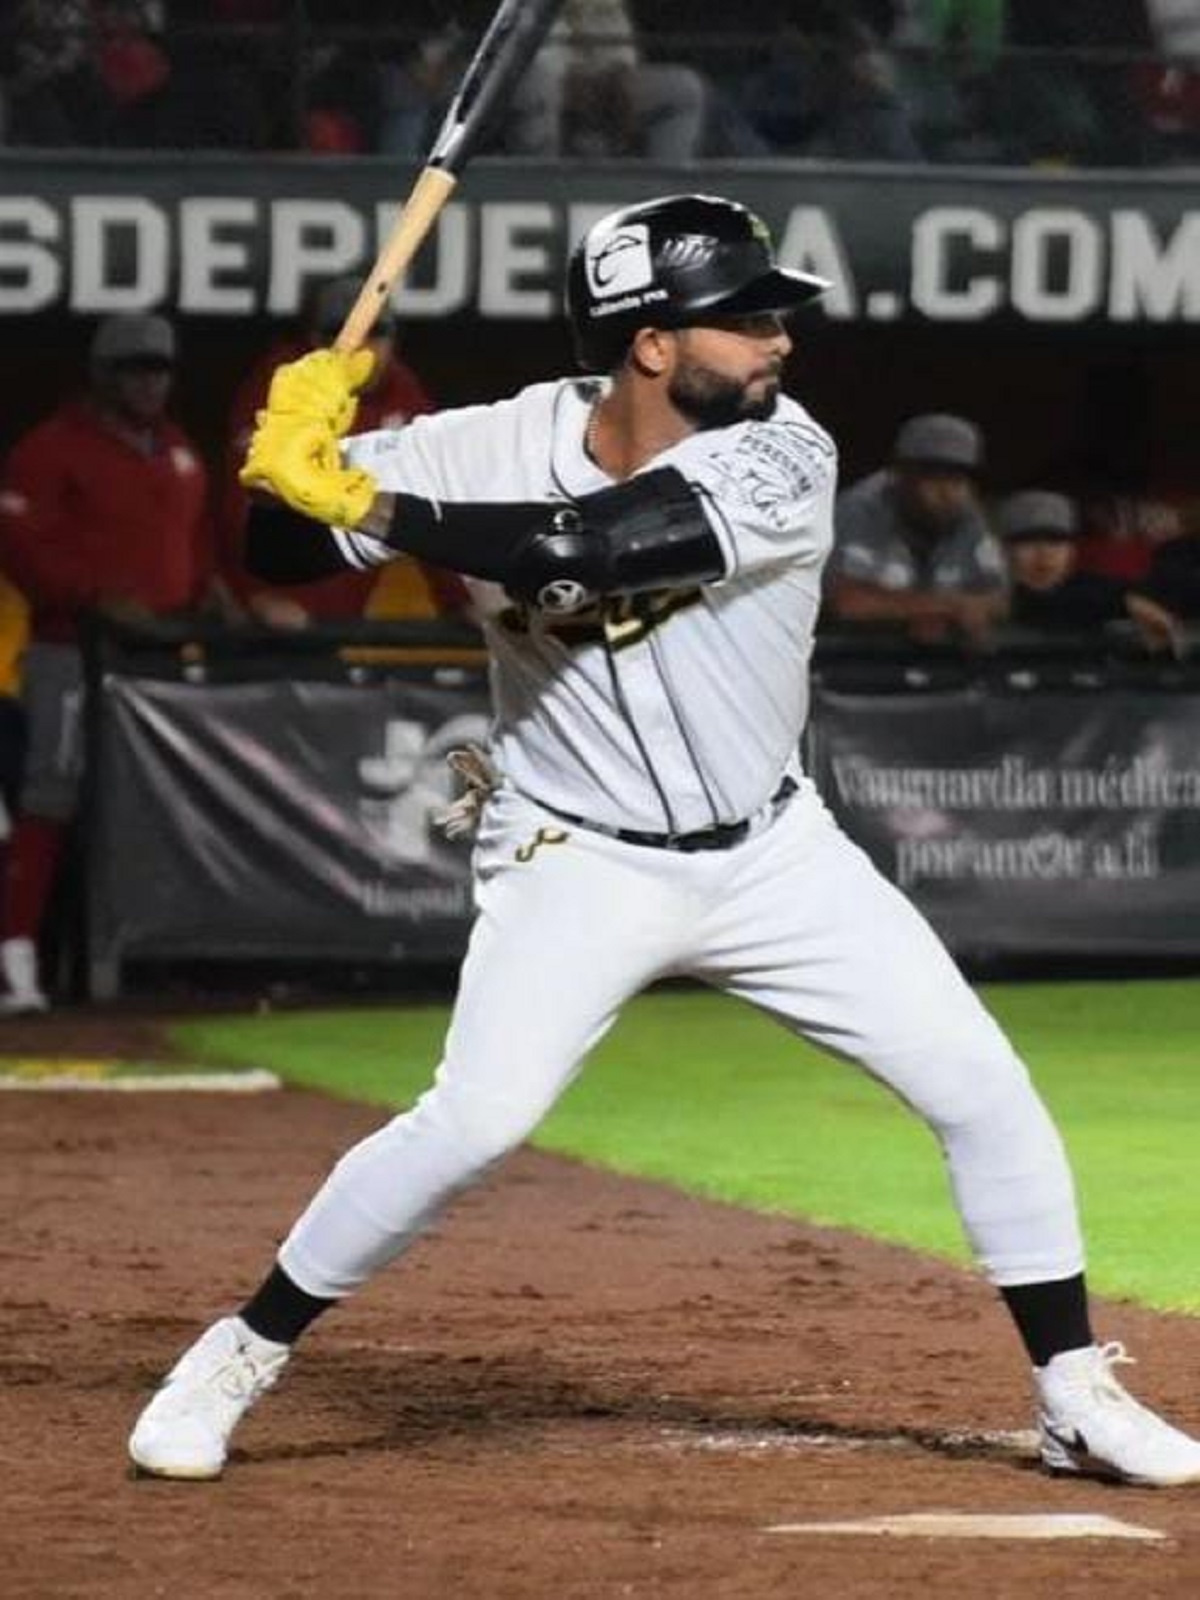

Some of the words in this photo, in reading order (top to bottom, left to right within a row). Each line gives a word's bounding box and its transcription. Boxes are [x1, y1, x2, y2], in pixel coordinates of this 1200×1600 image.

[831, 754, 1049, 808] Vanguardia
[897, 837, 958, 886] por
[1093, 843, 1123, 879] a
